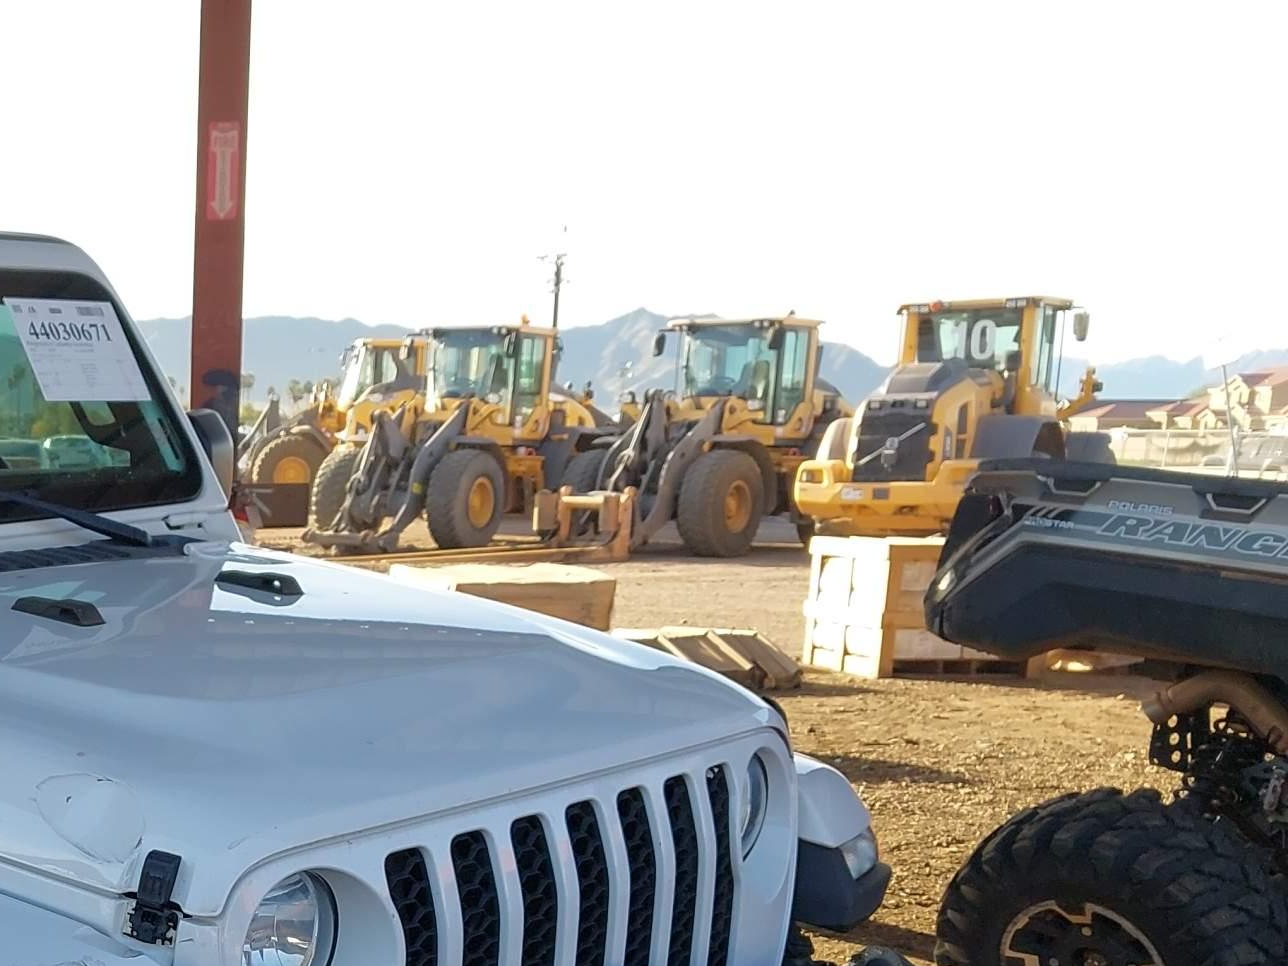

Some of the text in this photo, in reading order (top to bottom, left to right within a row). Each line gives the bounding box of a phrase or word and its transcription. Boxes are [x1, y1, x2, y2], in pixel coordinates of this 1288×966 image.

[28, 321, 112, 342] 44030671
[952, 319, 997, 360] 10
[1108, 500, 1173, 515] POLARIS
[1097, 513, 1288, 559] RANG
